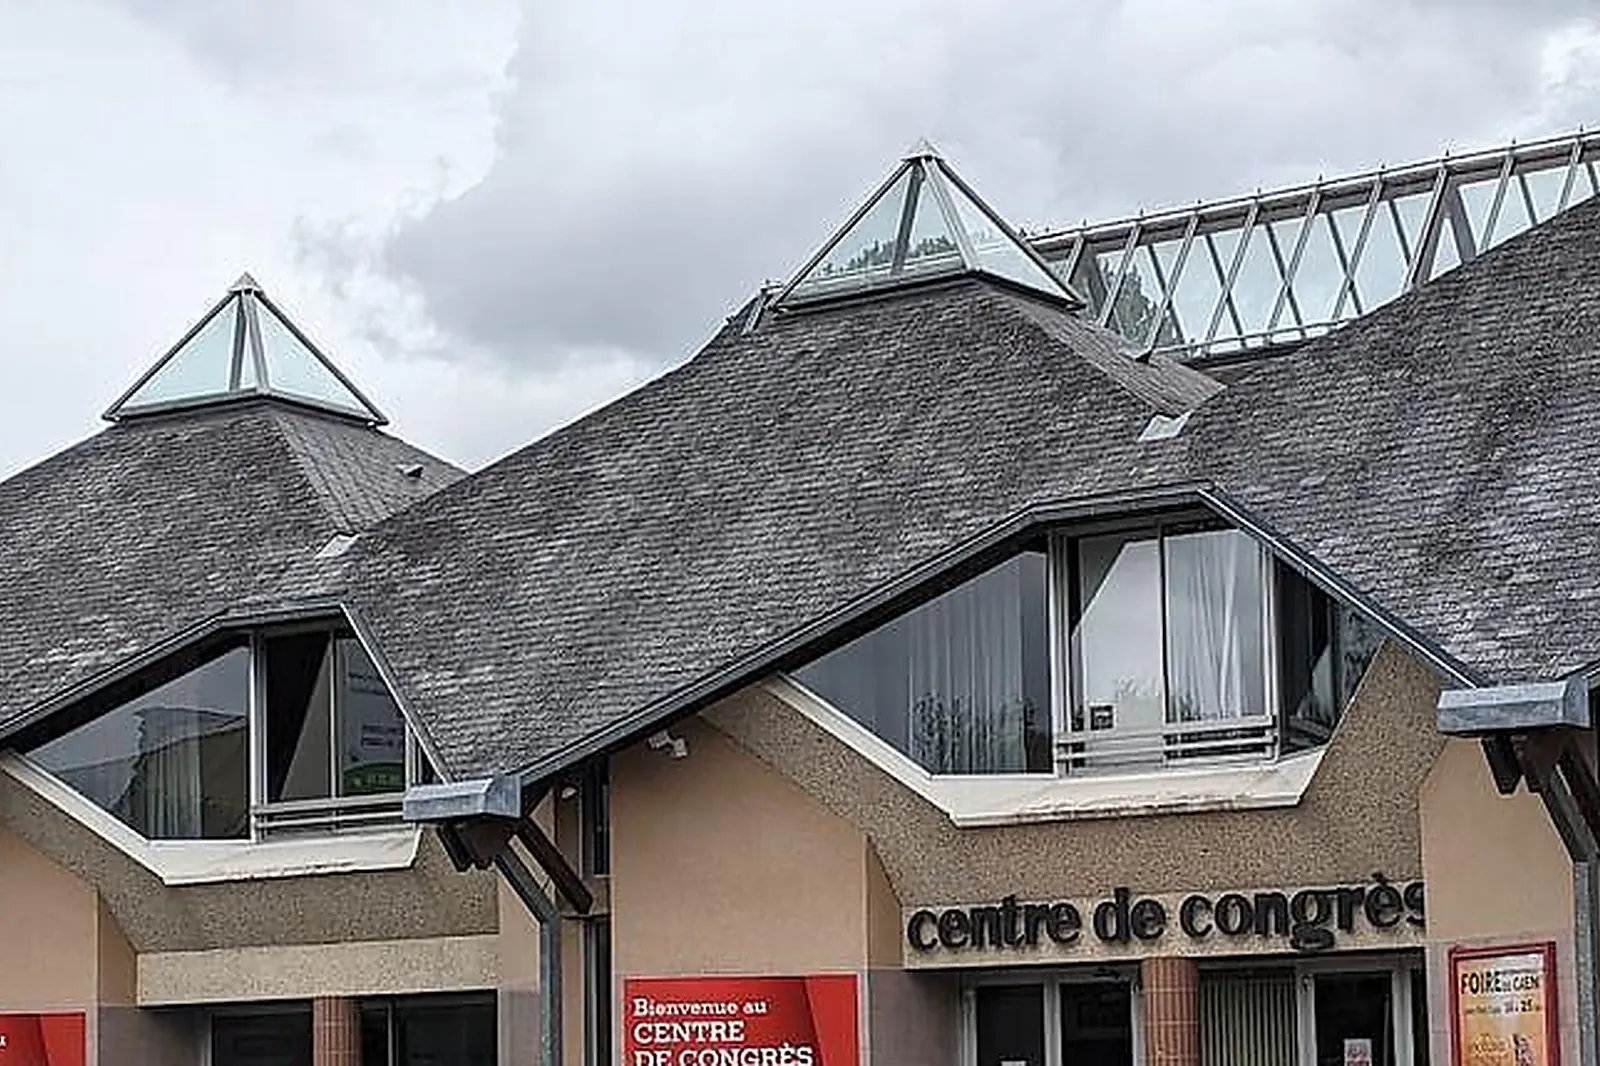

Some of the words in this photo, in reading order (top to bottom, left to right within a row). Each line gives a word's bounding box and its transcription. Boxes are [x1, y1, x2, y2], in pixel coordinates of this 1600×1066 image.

[907, 894, 1081, 953] centre
[1093, 887, 1167, 944] de
[1461, 971, 1502, 994] FOIRE
[633, 998, 738, 1016] Bienvenue
[742, 1000, 768, 1014] au
[633, 1020, 745, 1043] CENTRE
[633, 1049, 672, 1066] DE
[679, 1042, 814, 1066] CONGRÈS
